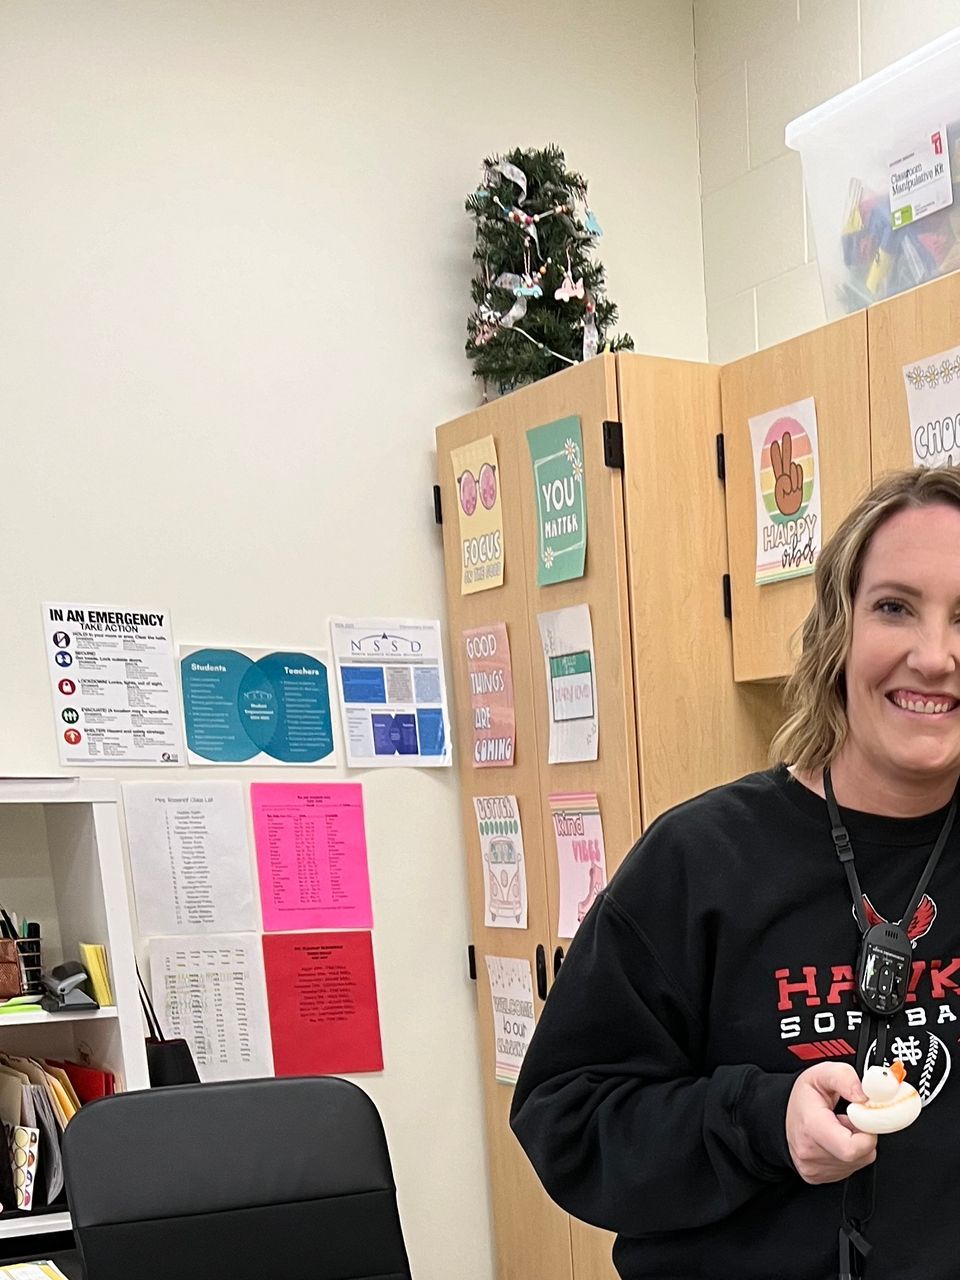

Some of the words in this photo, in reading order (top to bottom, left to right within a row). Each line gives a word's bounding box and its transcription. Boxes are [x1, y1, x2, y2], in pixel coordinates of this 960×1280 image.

[542, 476, 575, 512] YOU
[544, 513, 579, 539] MATTER
[763, 514, 817, 551] HAPPY
[463, 529, 501, 568] FOCUS
[49, 608, 63, 621] IN
[67, 609, 84, 622] AN
[88, 610, 164, 626] EMERGENCY
[80, 622, 102, 631] TAKE
[105, 623, 138, 633] ACTION
[466, 633, 497, 659] GOOD
[190, 662, 226, 672] Students
[284, 666, 320, 676] Teachers
[470, 669, 505, 695] THINGS
[475, 707, 491, 729] ARE
[475, 737, 512, 763] COMING
[554, 811, 585, 837] kind
